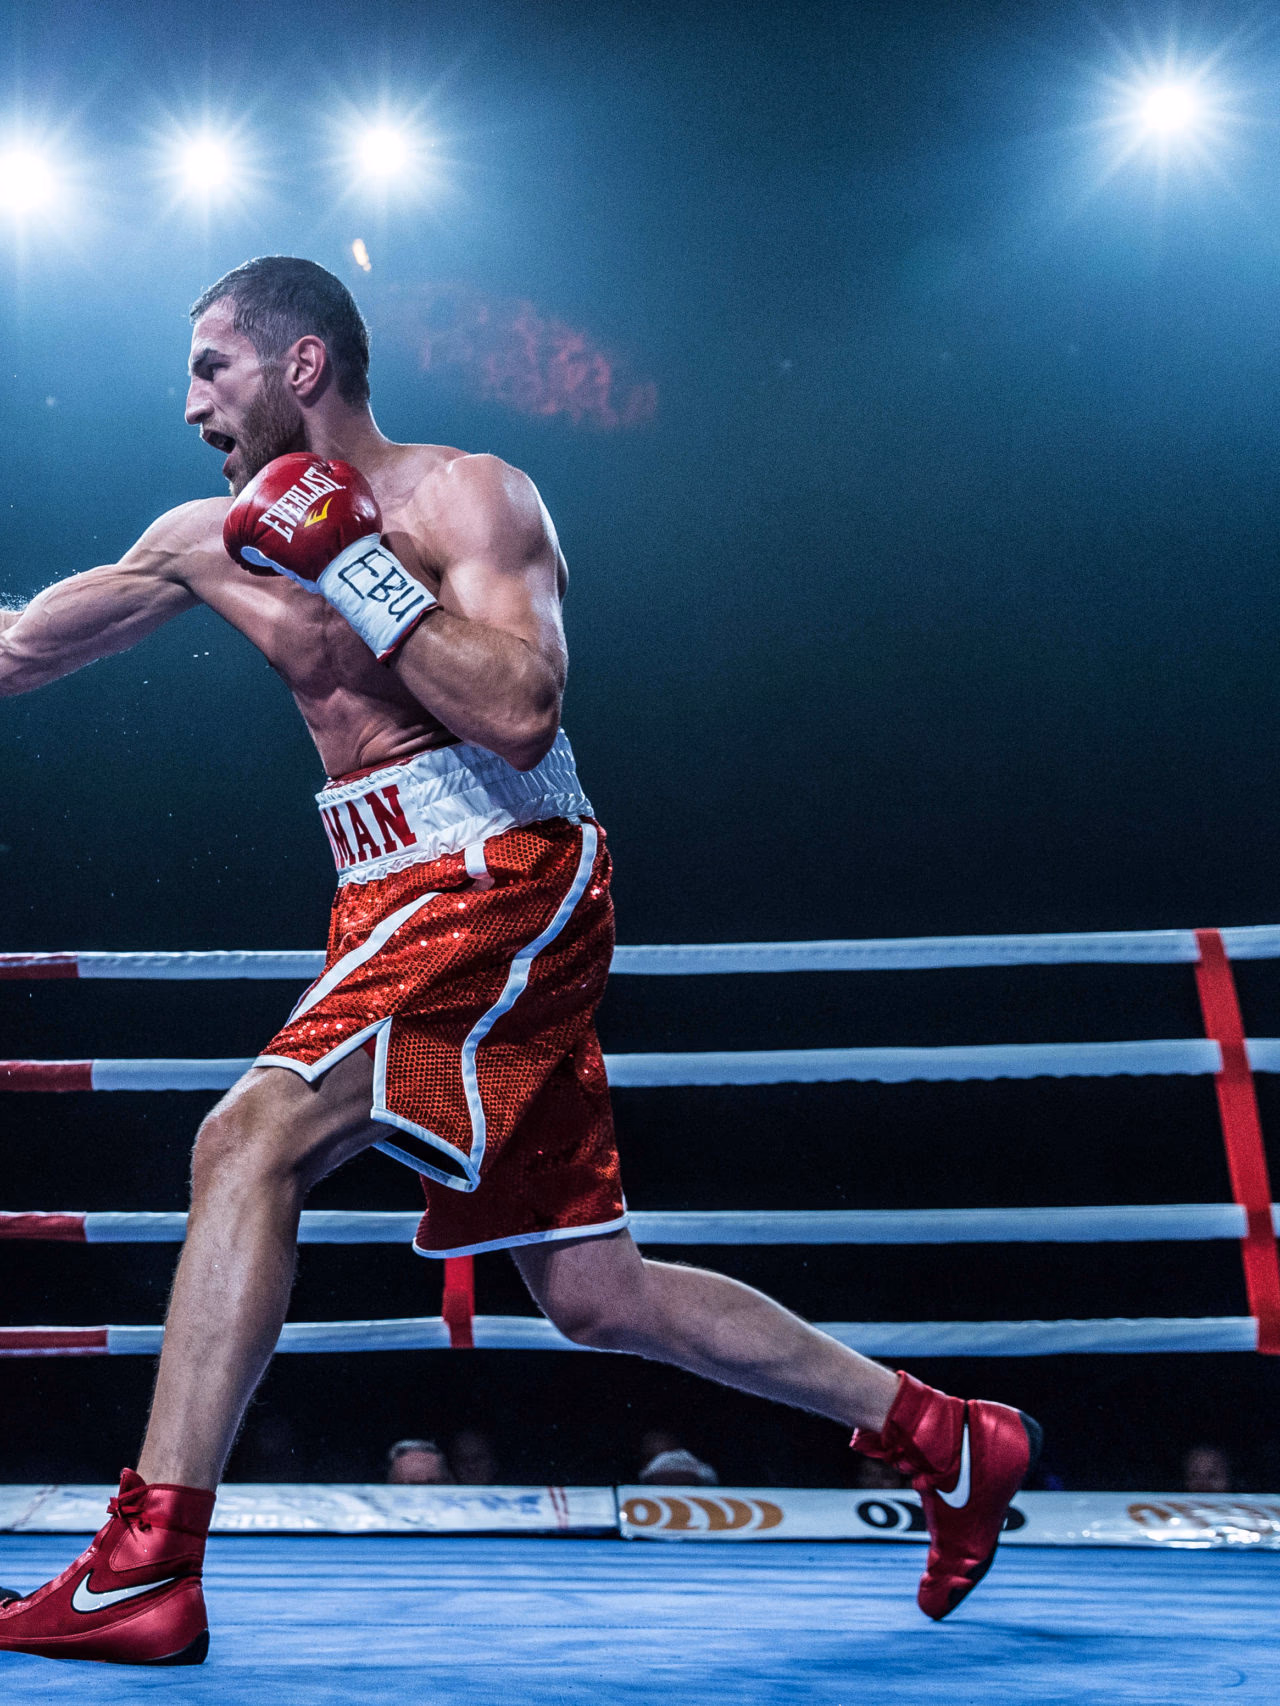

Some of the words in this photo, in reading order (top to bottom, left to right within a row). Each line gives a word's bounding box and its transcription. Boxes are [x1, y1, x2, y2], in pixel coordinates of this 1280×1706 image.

[258, 466, 346, 543] EVERLAST
[338, 548, 424, 622] EBU
[321, 784, 417, 868] MAN
